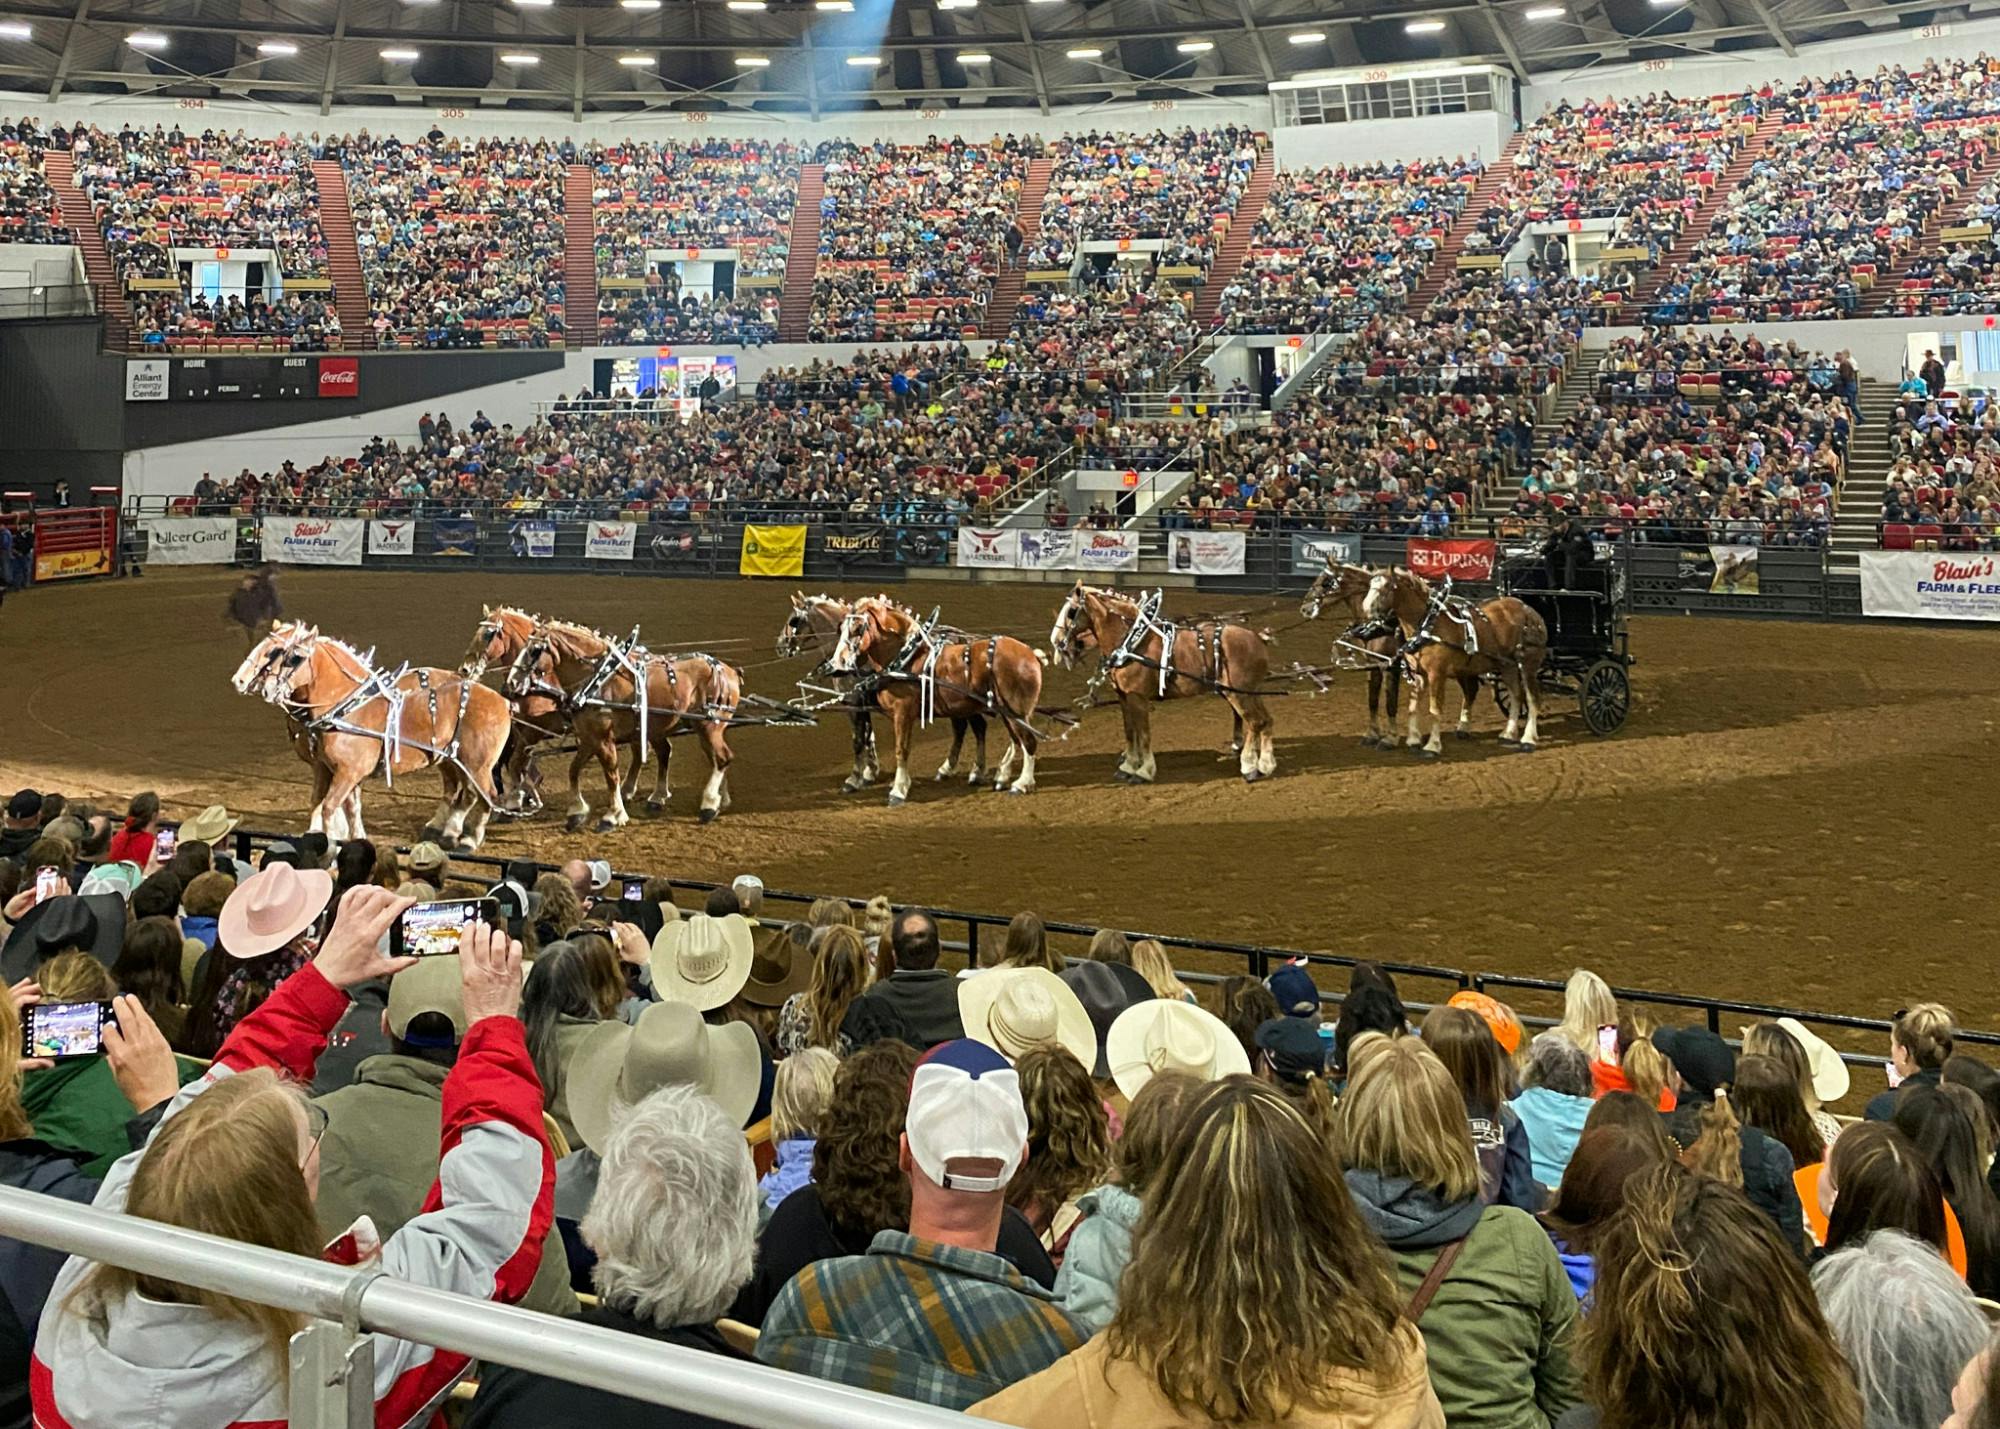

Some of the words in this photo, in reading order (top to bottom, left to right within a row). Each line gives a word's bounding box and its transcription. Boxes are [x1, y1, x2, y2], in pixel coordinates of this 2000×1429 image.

[1921, 25, 1942, 38] 311
[1644, 60, 1665, 71] 310
[1364, 71, 1387, 81] 309
[180, 99, 204, 109] 304
[1151, 101, 1173, 111] 308
[441, 108, 465, 118] 305
[686, 112, 708, 122] 306
[921, 109, 942, 119] 307
[184, 360, 206, 368] HOME
[283, 358, 307, 367] GUEST
[132, 373, 163, 382] Alliant
[132, 381, 162, 391] Energy
[217, 385, 240, 393] PERIOD
[132, 389, 162, 398] Center
[294, 521, 332, 537] Blain's
[155, 530, 228, 545] UlcerGard
[283, 537, 306, 546] FARM
[312, 538, 339, 548] FLEET
[825, 535, 880, 549] TRIBUTE
[1431, 550, 1491, 568] PURINA
[1933, 556, 1994, 582] Blain's
[1917, 581, 1955, 593] FARM
[1956, 585, 1966, 593] &
